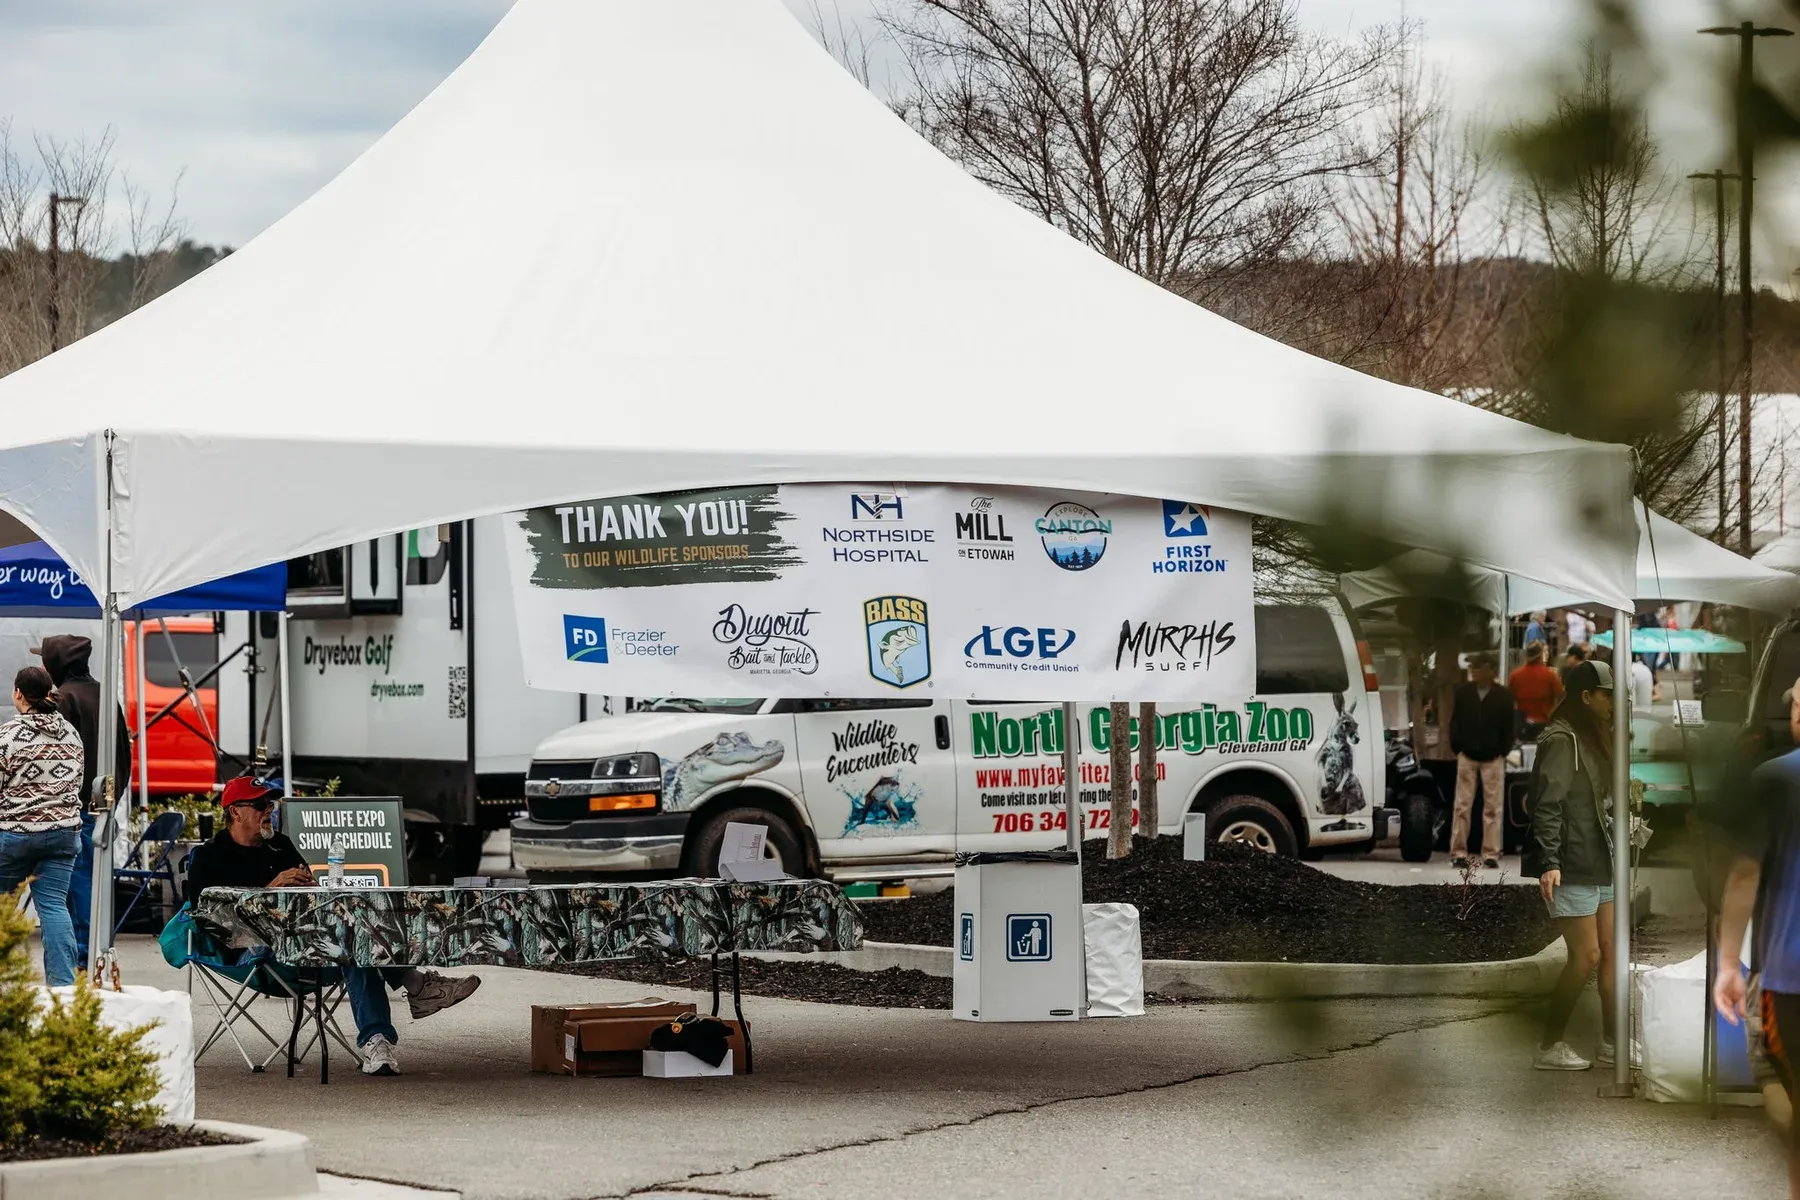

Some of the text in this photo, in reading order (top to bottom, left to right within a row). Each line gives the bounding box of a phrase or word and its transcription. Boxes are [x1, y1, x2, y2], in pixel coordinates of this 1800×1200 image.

[971, 496, 994, 514] The
[1055, 506, 1089, 518] EXPLORE
[555, 500, 749, 544] THANK YOU!
[955, 512, 1013, 541] MILL
[1035, 518, 1112, 535] CANTON
[823, 527, 935, 542] NORTHSIDE
[563, 544, 751, 568] TO OUR WILDLIFE SPONSORS
[833, 547, 929, 562] HOSPITAL
[968, 548, 1014, 560] ETOWAH
[1166, 545, 1211, 558] FIRST
[1153, 560, 1226, 573] HORIZON
[21, 567, 65, 599] way
[712, 603, 821, 646] Dugout
[573, 628, 598, 646] FD
[612, 628, 666, 642] Frazier
[981, 625, 1058, 659] LGE
[1116, 619, 1236, 671] MURPHS
[304, 635, 394, 675] Dryvebox Golf
[728, 646, 767, 669] Bait
[773, 646, 811, 667] Tackle
[965, 660, 1079, 672] Community Credit Union
[1145, 662, 1201, 671] SURF
[371, 680, 424, 701] dryvebox.com
[1245, 701, 1315, 745] Zoo
[832, 719, 898, 752] Wildlife
[1218, 738, 1307, 754] Cleveland GA
[826, 741, 920, 783] Encounters
[981, 793, 1006, 807] Come
[1007, 791, 1025, 806] visit
[1027, 793, 1038, 805] us
[1039, 792, 1048, 805] or
[1079, 788, 1097, 804] ring
[1098, 788, 1111, 802] the
[301, 810, 385, 828] WILDLIFE EXPO
[992, 812, 1034, 834] 706
[299, 832, 392, 850] SHOW SCHEDULE
